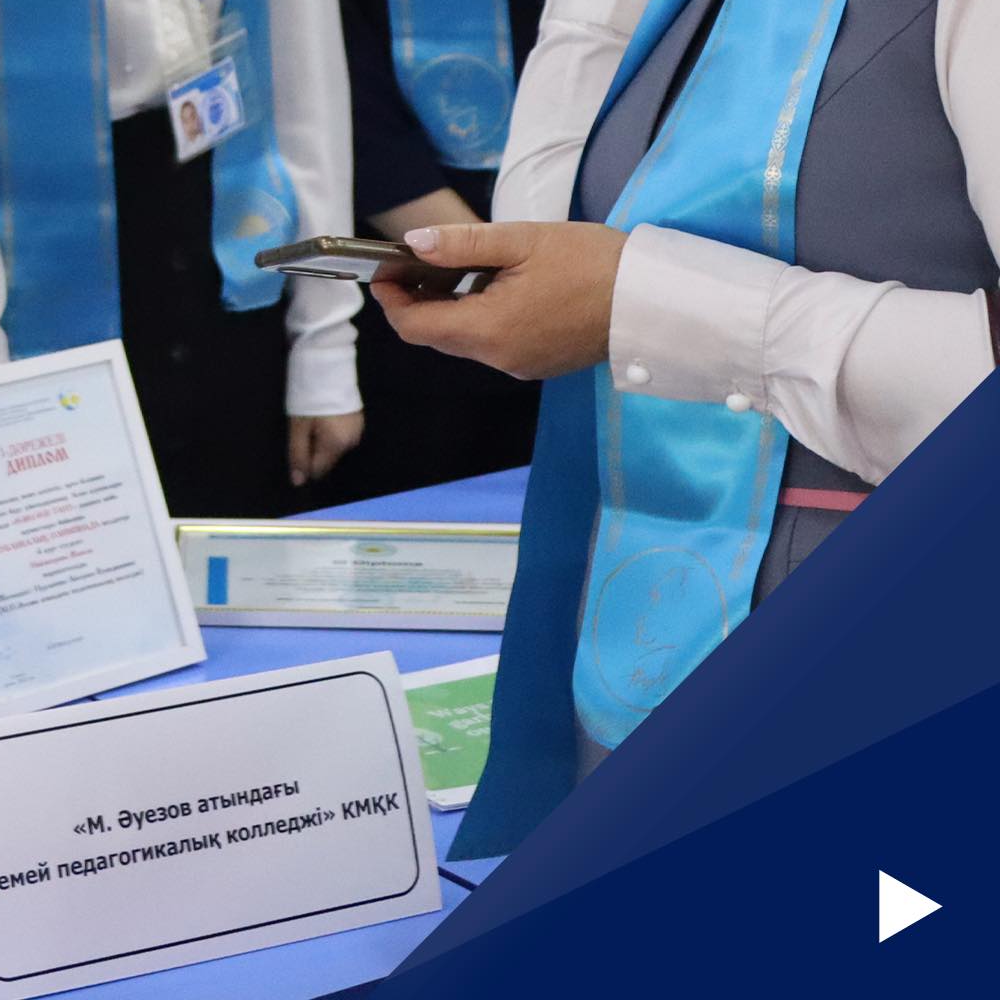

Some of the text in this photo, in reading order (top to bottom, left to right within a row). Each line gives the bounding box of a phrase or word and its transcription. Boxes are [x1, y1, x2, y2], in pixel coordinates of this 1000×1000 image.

[57, 830, 222, 879] педагогикалық
[226, 808, 337, 845] колледжі»
[341, 792, 400, 821] КМҚК
[73, 780, 300, 837] «М. Әуезов атындағы
